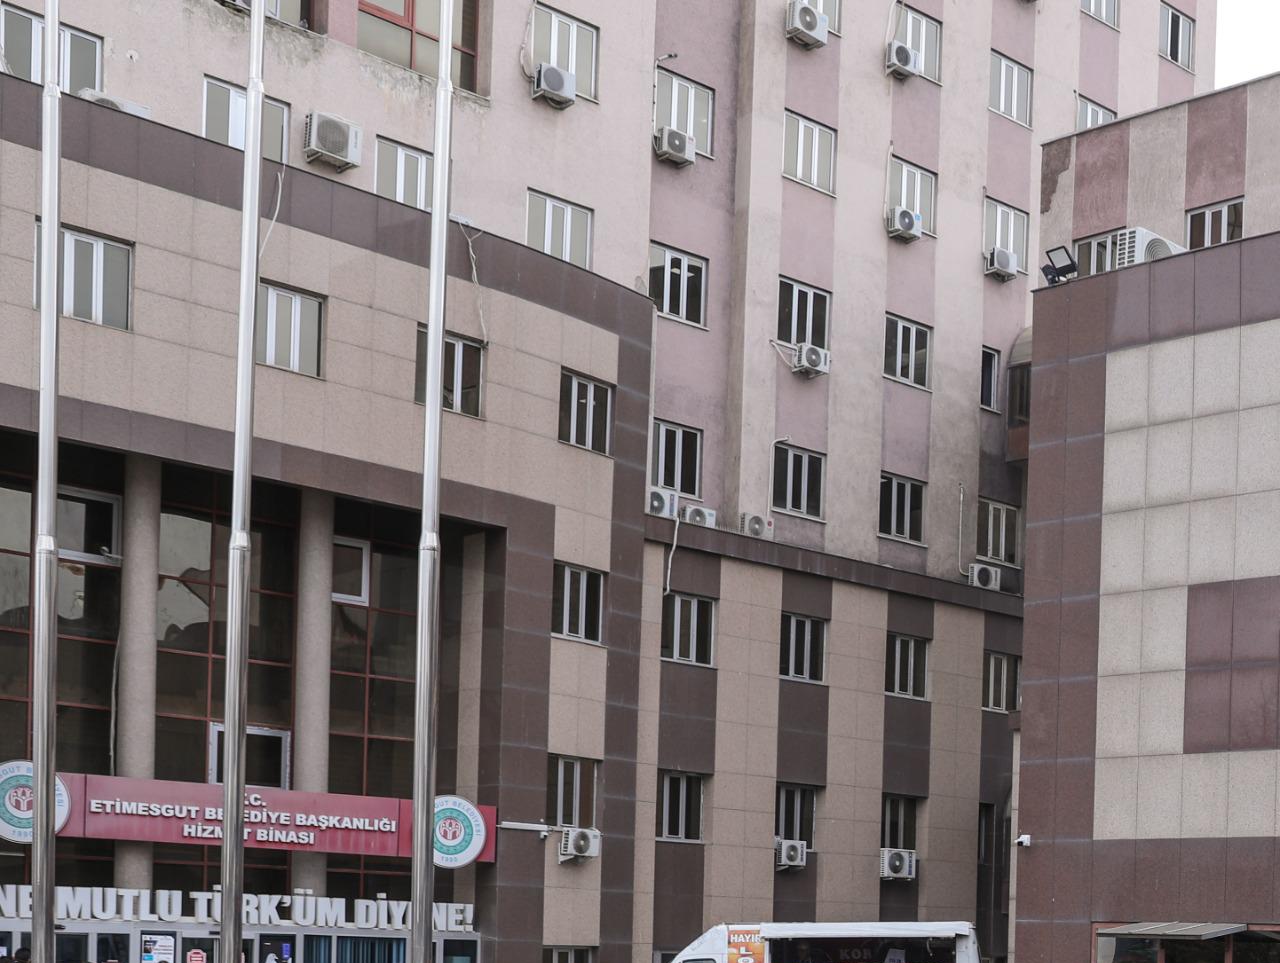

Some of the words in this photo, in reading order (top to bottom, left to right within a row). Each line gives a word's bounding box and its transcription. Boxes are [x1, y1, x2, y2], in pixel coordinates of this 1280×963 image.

[244, 792, 267, 806] .C.
[89, 798, 200, 819] ETİMESGUT
[204, 806, 291, 825] BEEDİYE
[295, 814, 397, 832] BAŞKANLIĞI
[183, 823, 251, 841] HİZMT
[256, 828, 315, 844] BİNASI
[54, 886, 182, 922] MUTLU
[354, 893, 474, 932] DİYNE!
[730, 933, 762, 943] HAYIR
